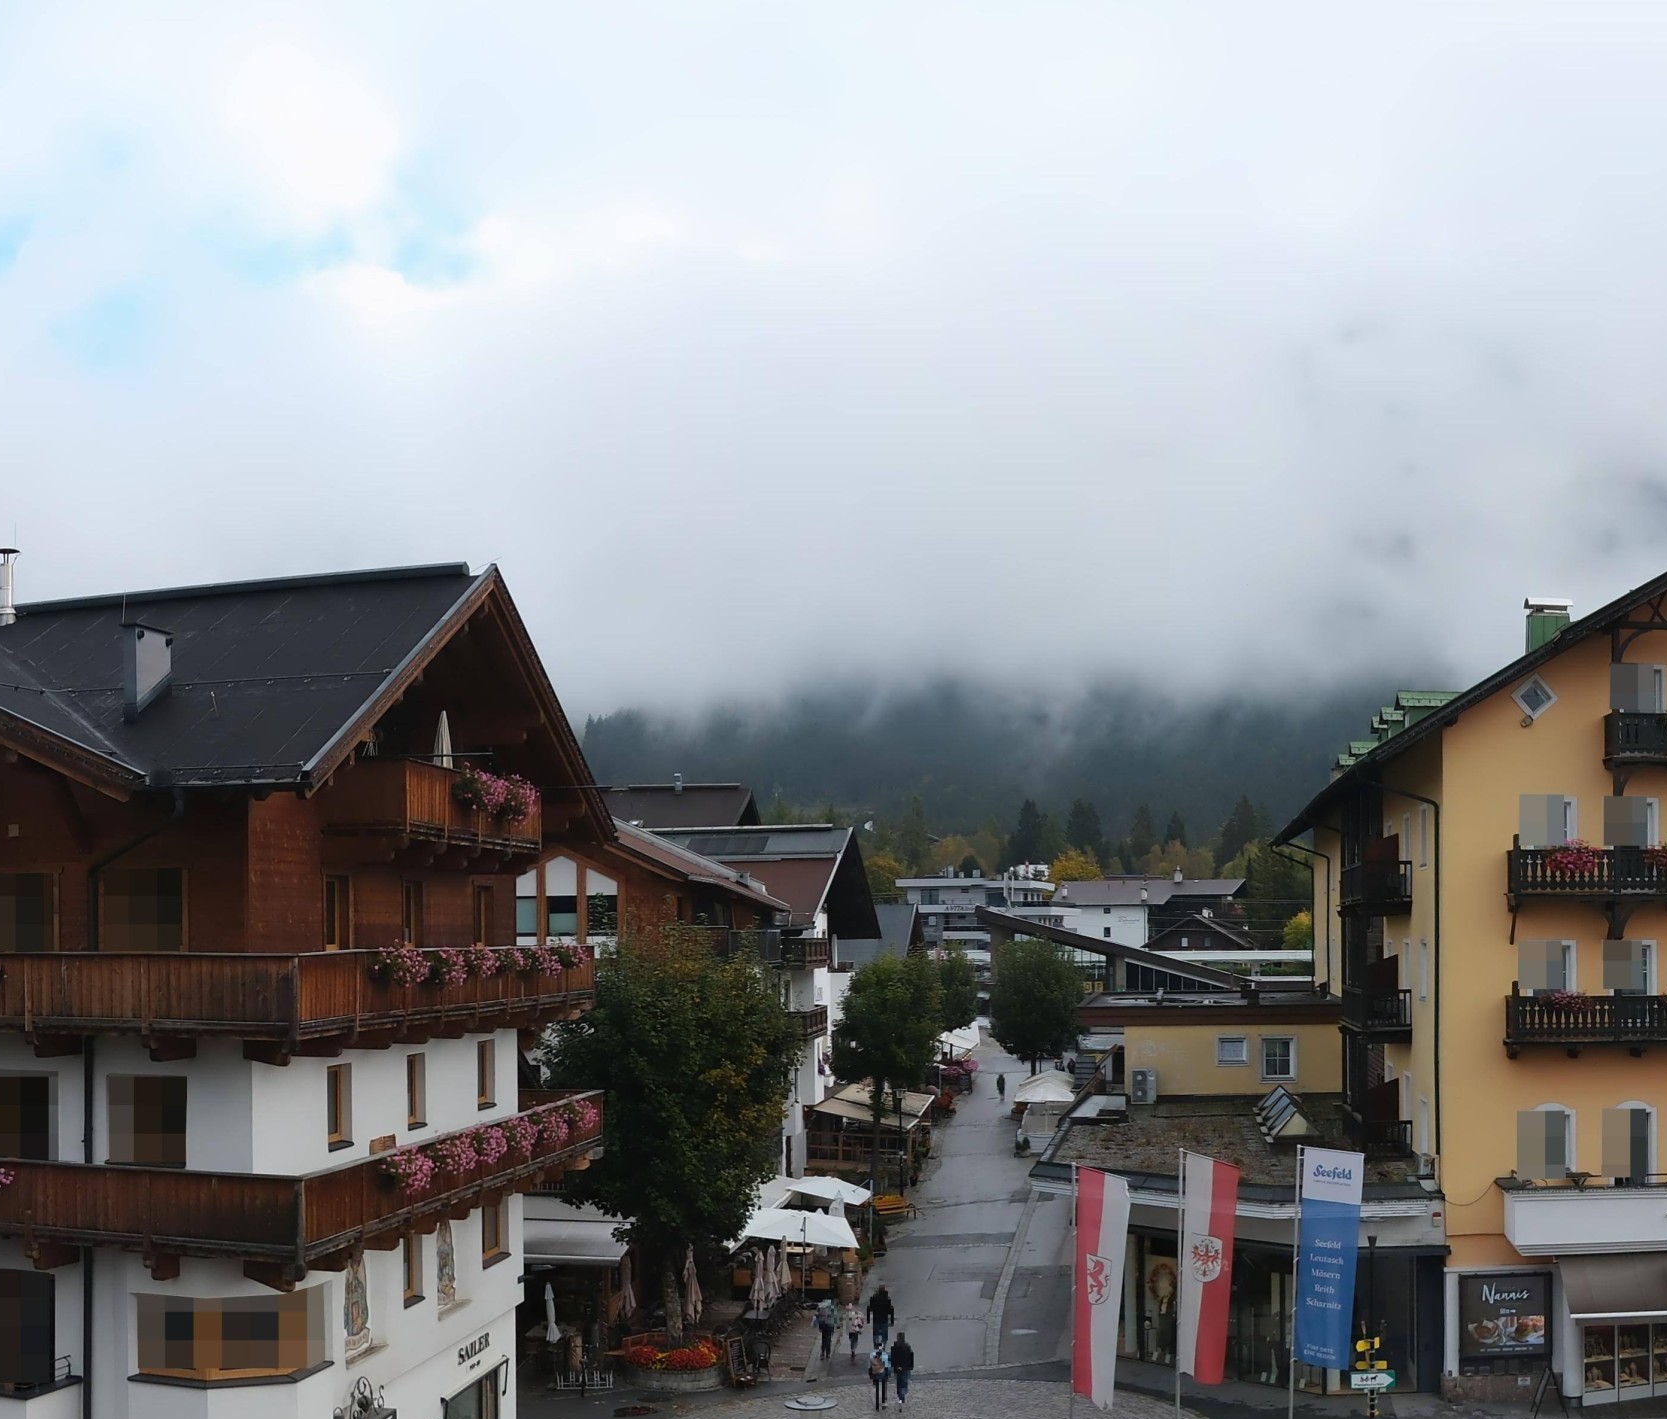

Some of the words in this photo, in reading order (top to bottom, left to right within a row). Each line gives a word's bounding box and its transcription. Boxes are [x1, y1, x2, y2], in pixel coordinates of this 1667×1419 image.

[1313, 1164, 1352, 1180] Seefeld
[1315, 1239, 1341, 1249] Seefeld
[1310, 1253, 1344, 1265] Leutasch
[1311, 1267, 1340, 1279] Mösern
[1314, 1284, 1335, 1294] Reith
[1482, 1282, 1529, 1304] Nannis
[1306, 1297, 1342, 1310] Scharnitz
[457, 1332, 490, 1366] SAILER
